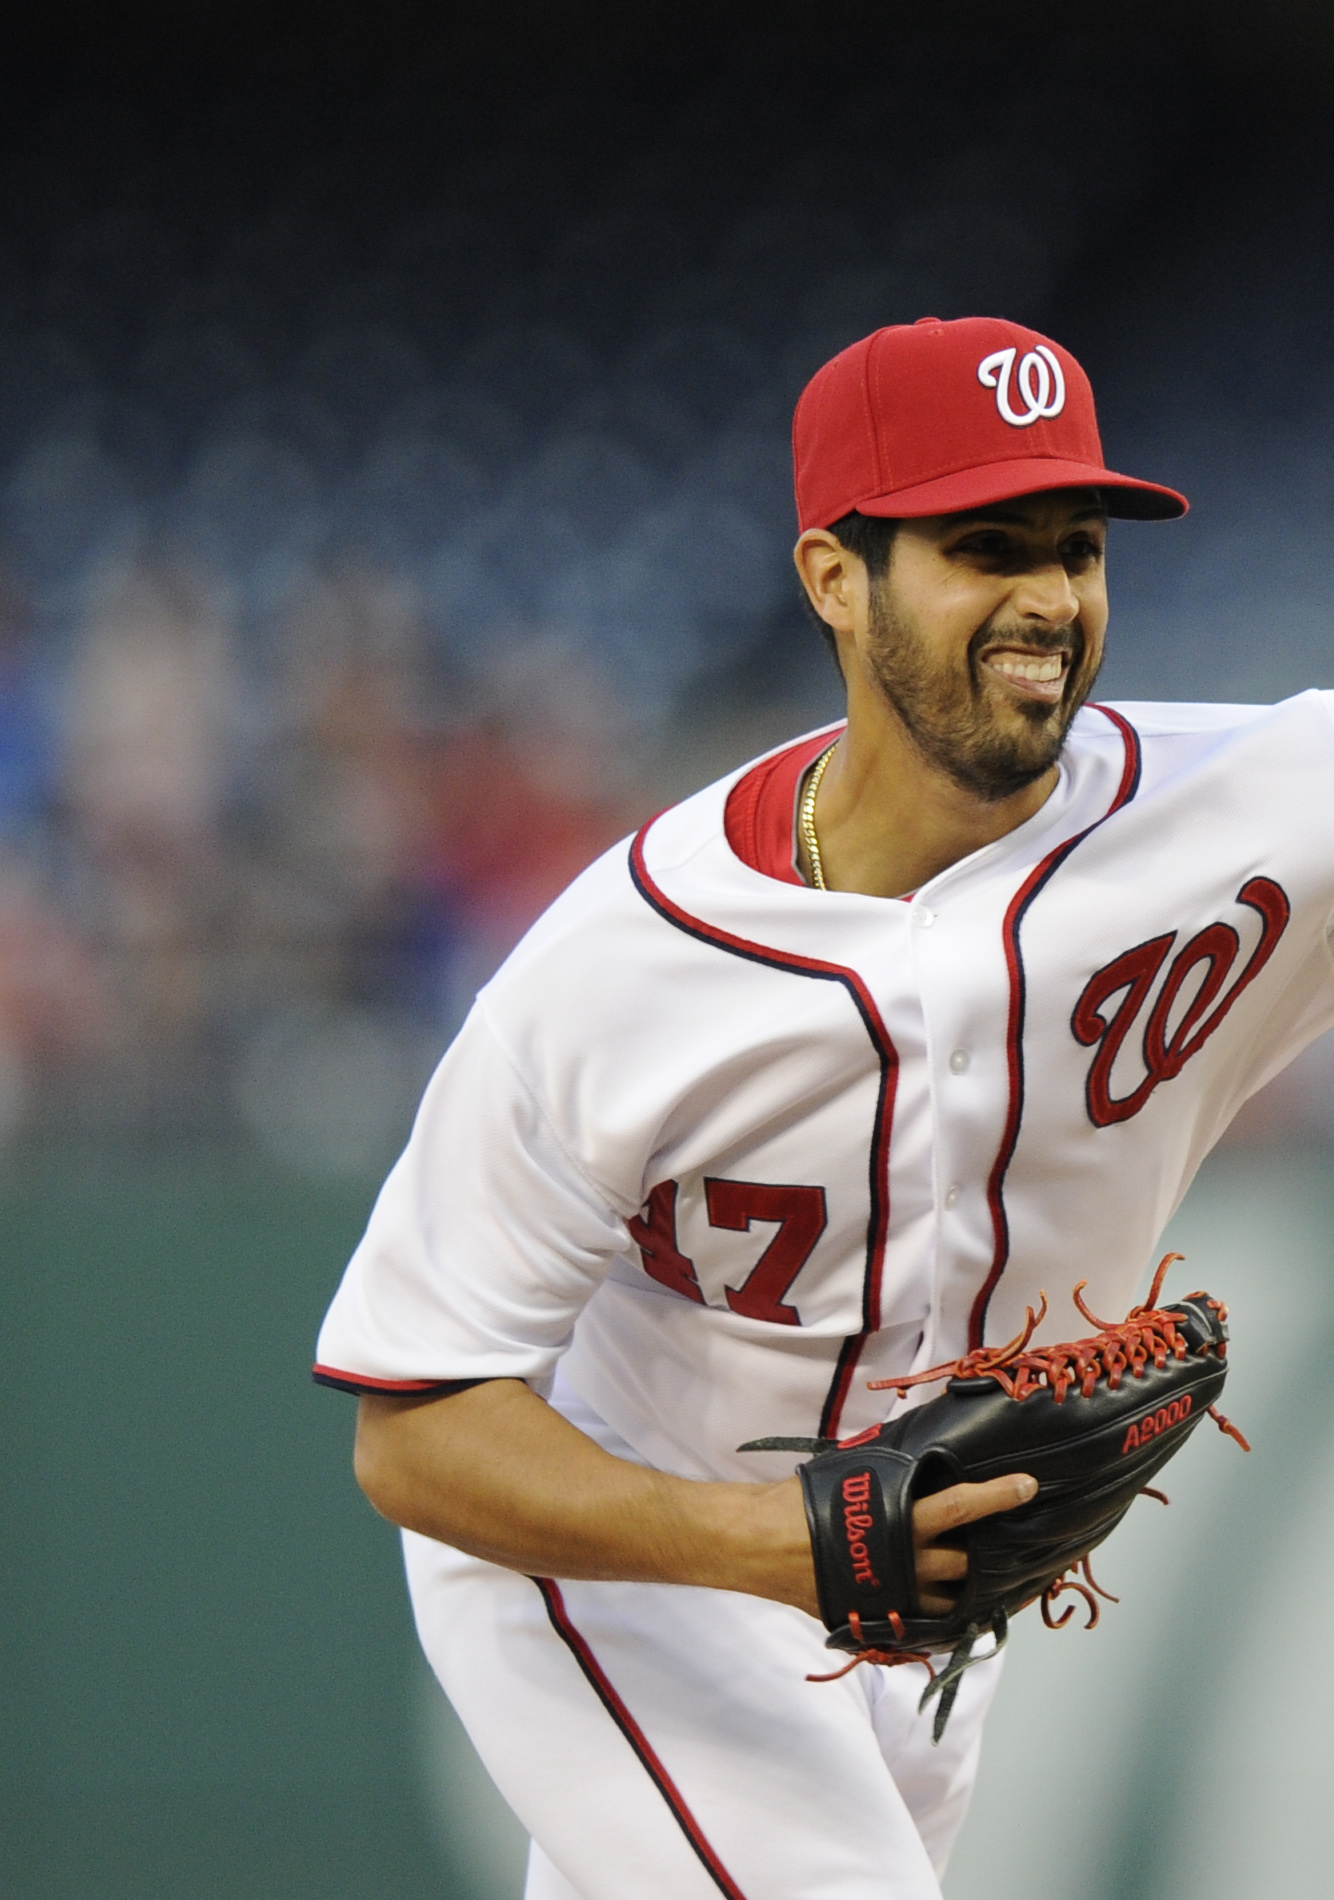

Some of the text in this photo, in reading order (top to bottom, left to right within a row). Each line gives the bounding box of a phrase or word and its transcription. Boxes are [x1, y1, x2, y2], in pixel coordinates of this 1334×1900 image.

[977, 344, 1066, 428] W
[1070, 875, 1290, 1128] W
[1122, 1394, 1192, 1454] A2000
[842, 1471, 875, 1584] Wilson
